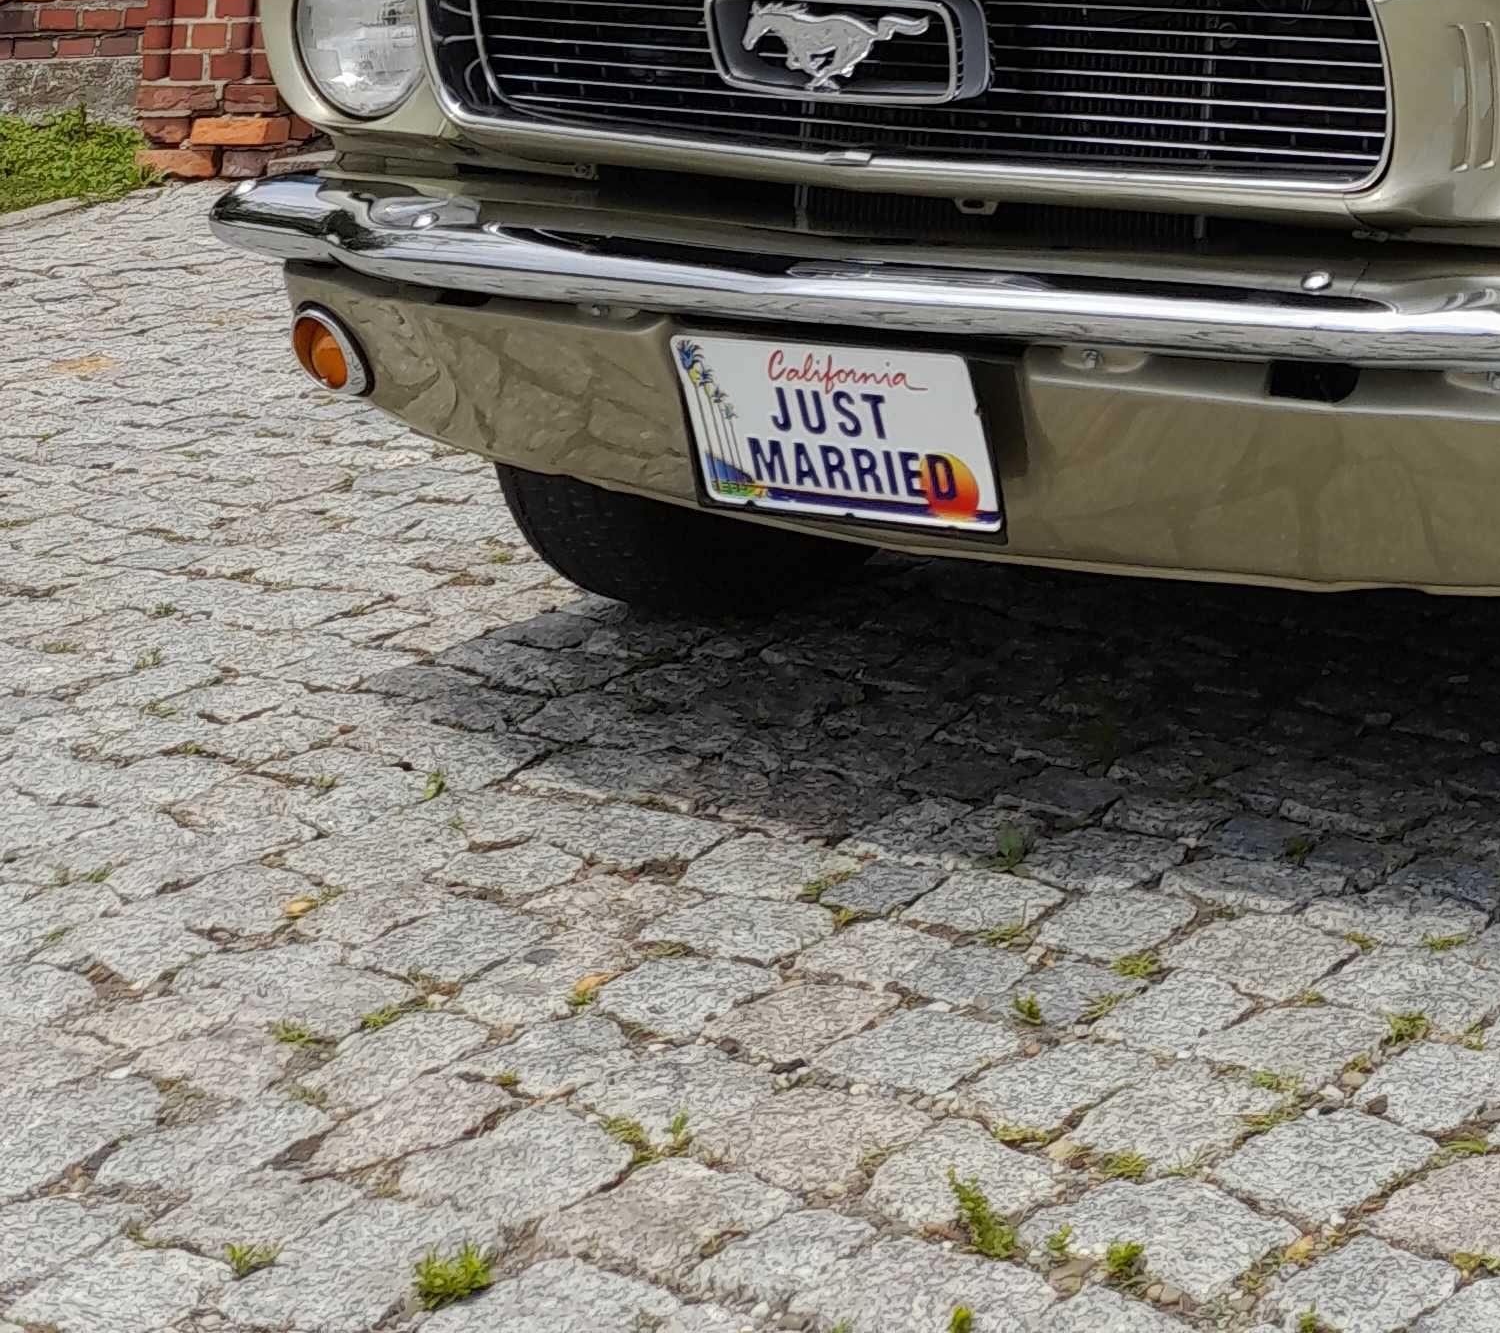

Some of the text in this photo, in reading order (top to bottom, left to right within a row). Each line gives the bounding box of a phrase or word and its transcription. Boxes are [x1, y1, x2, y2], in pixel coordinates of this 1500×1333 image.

[768, 350, 928, 394] California
[770, 387, 887, 440] JUST
[747, 437, 957, 500] MARRIED
